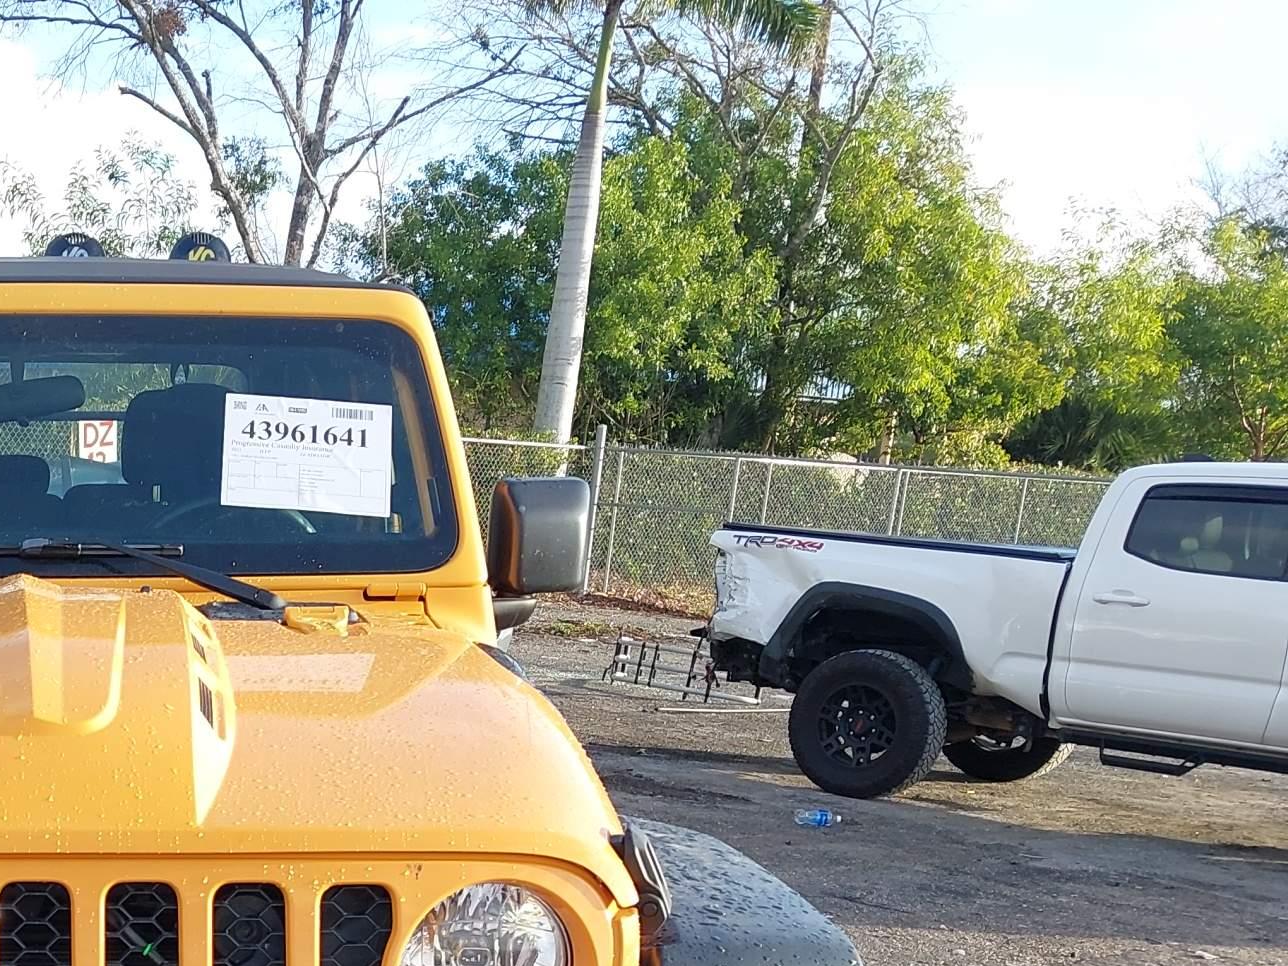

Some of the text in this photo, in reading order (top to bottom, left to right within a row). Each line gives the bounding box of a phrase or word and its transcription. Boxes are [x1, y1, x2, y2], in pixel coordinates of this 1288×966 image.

[83, 420, 114, 449] DZ
[241, 419, 368, 449] 43961641
[733, 534, 778, 548] TRD
